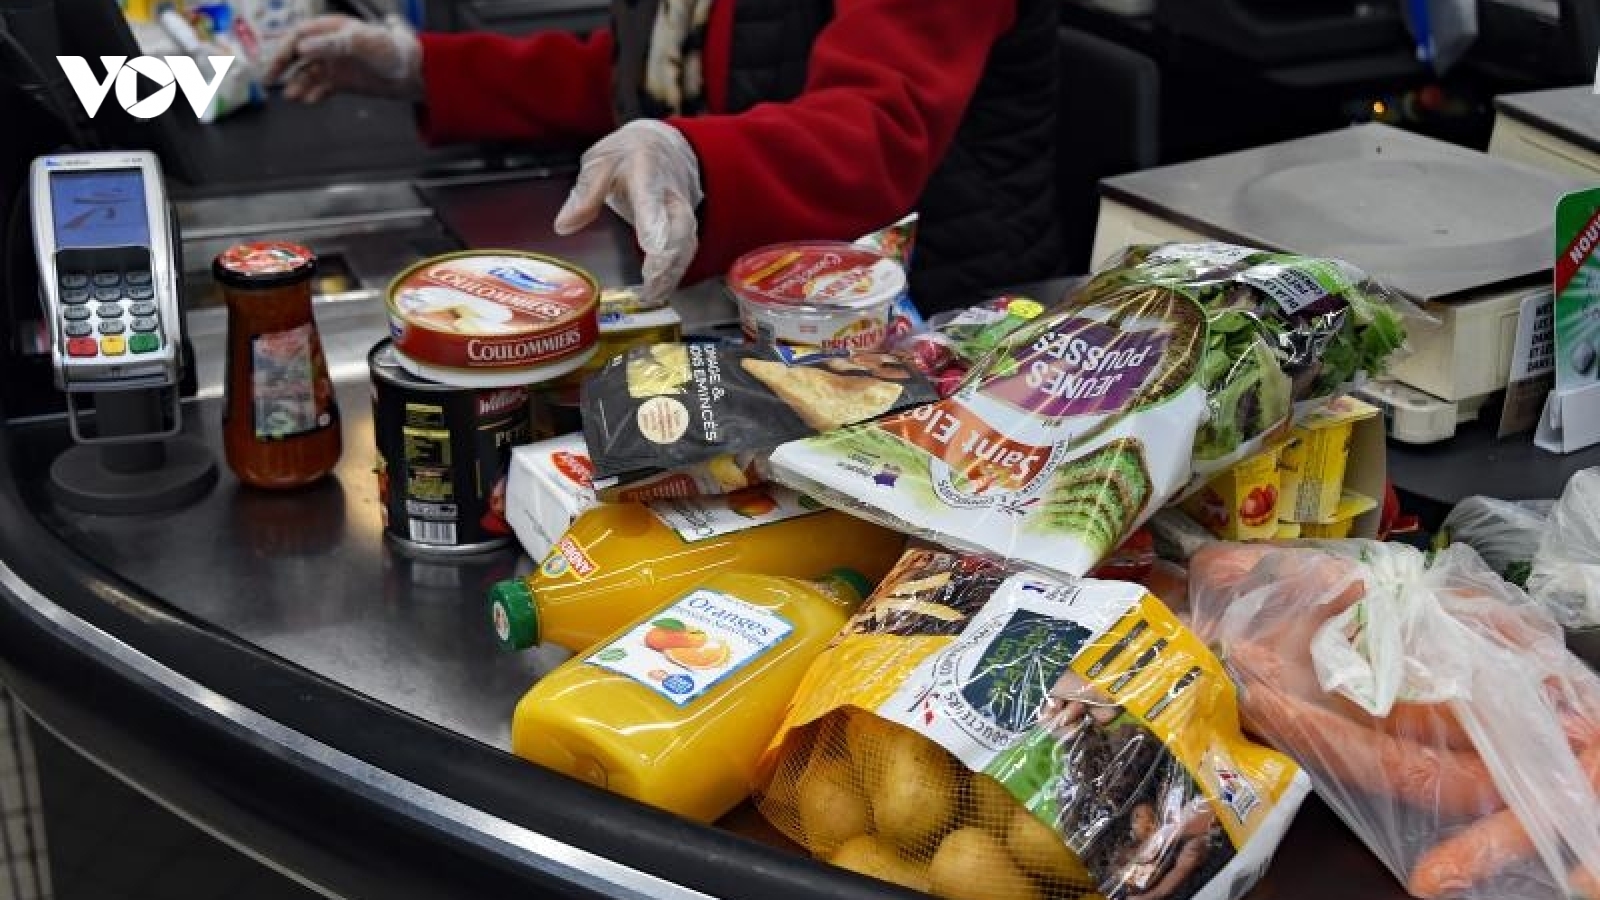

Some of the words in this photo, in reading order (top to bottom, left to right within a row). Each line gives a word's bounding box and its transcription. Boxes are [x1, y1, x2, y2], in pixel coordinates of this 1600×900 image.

[467, 330, 581, 361] COULOMMIERS
[1033, 332, 1153, 372] POUSSES
[1025, 361, 1123, 399] JEUNES
[963, 428, 1040, 479] Saint
[689, 597, 769, 637] Oranges
